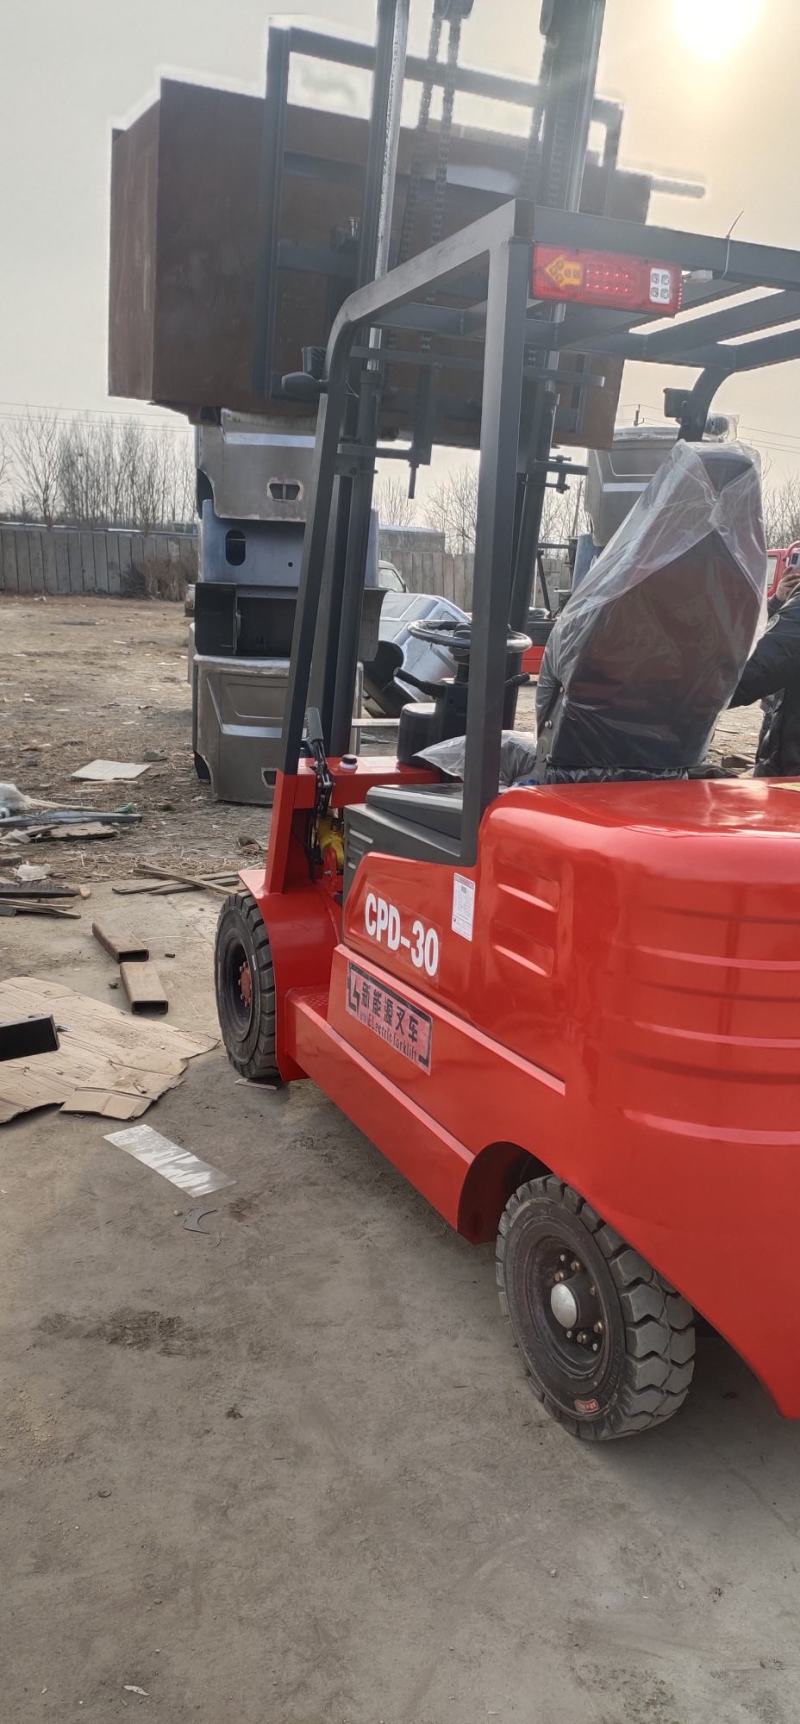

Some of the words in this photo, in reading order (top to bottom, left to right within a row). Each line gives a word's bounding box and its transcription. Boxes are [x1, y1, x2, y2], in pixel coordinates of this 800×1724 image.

[365, 893, 439, 976] CPD-30
[360, 981, 419, 1043] 新能源叉车
